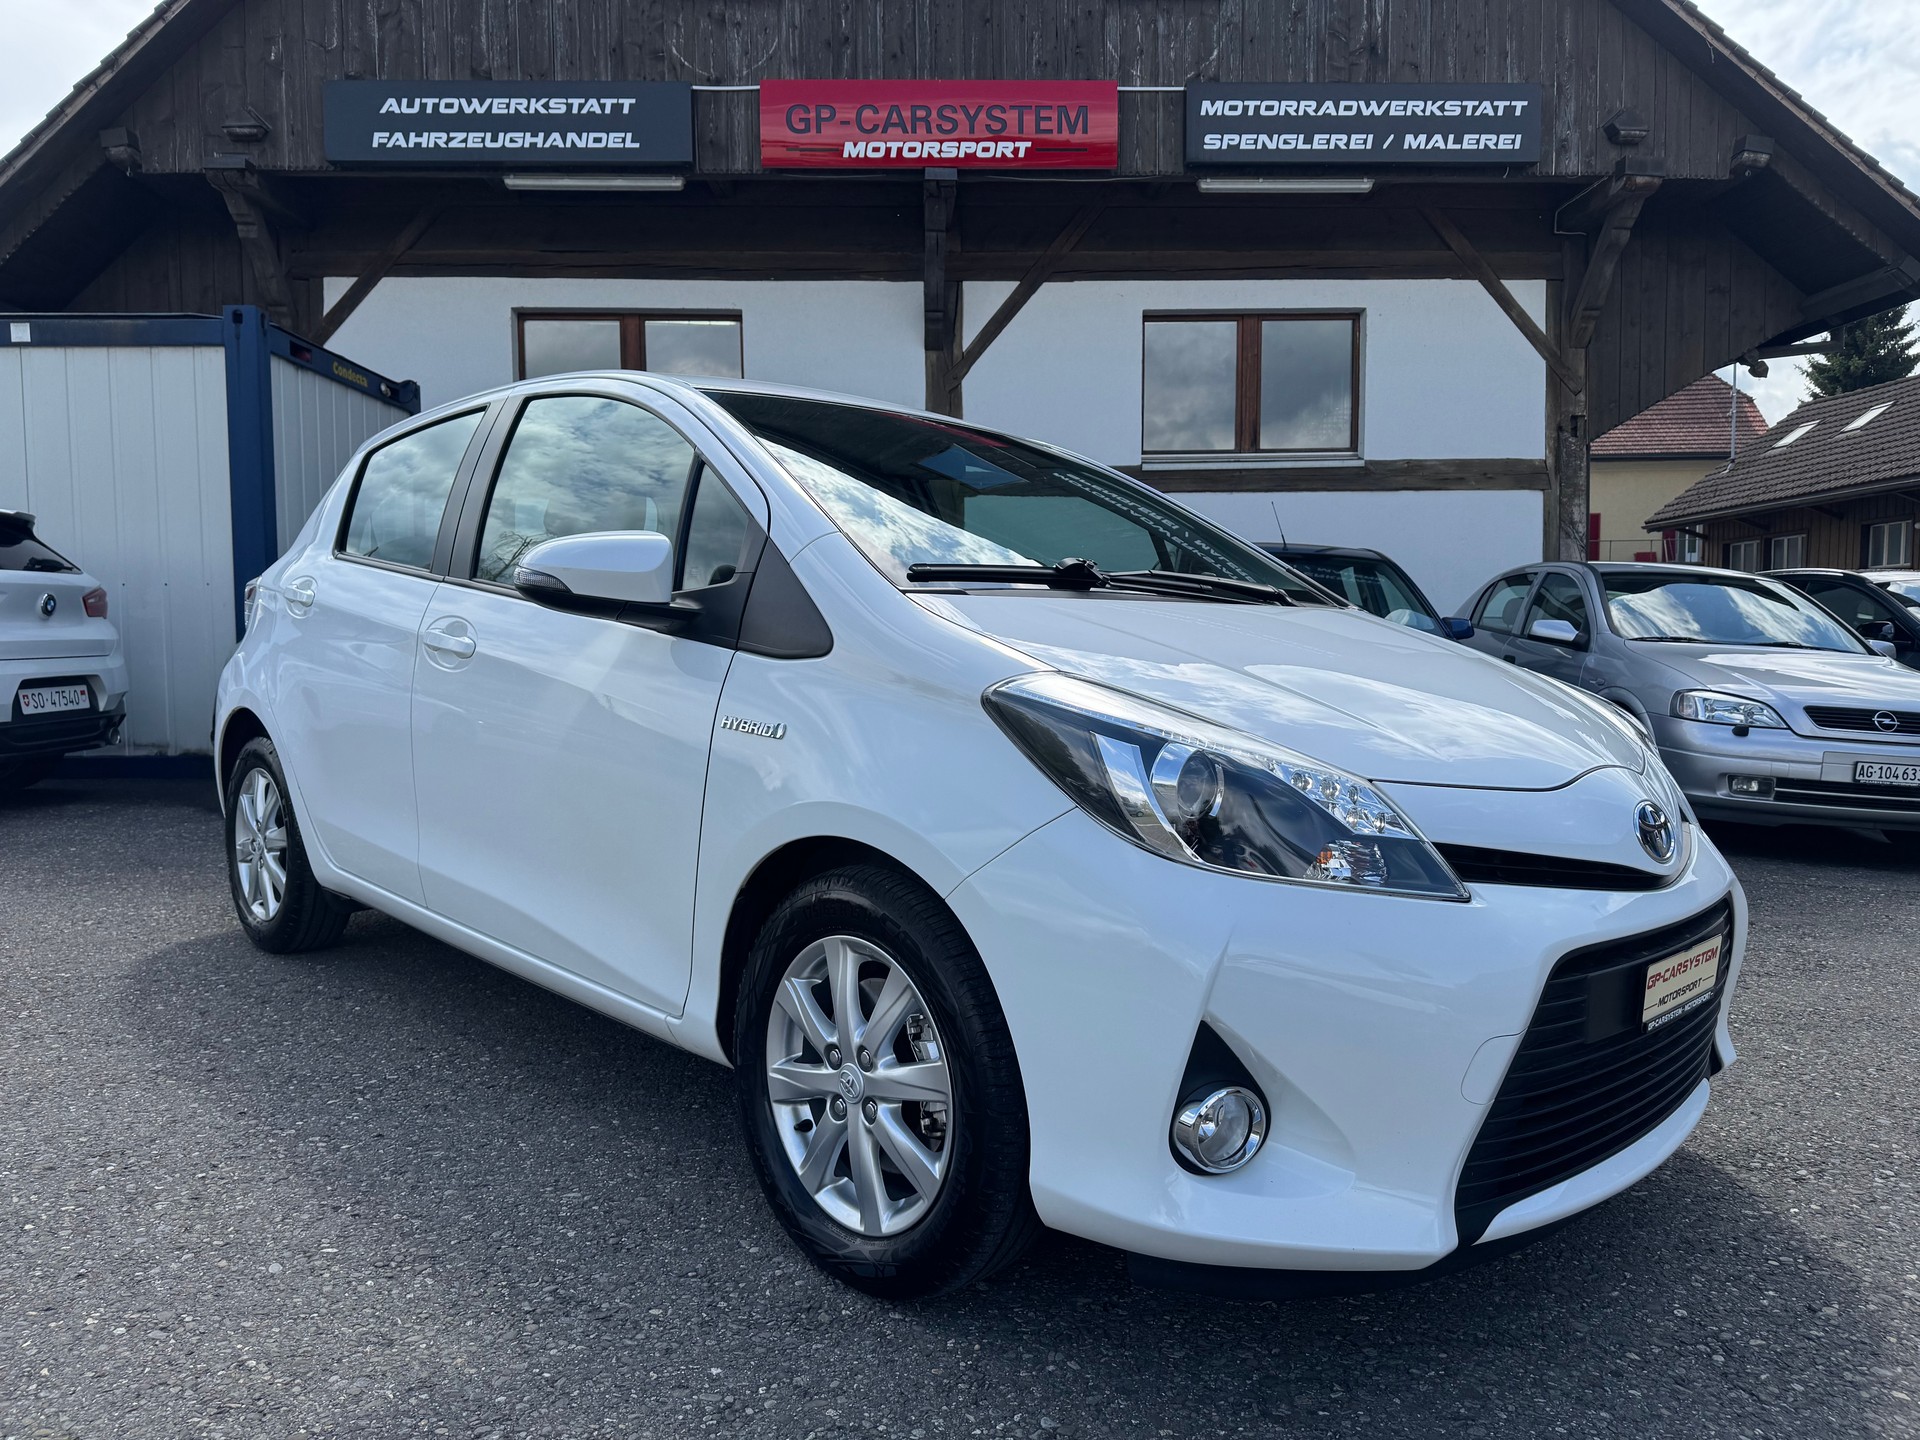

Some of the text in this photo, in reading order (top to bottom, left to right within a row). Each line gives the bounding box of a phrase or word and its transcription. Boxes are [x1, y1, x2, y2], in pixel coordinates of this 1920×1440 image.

[379, 97, 636, 114] AUTOWERKSTATT
[1200, 100, 1528, 116] MOTORRADWERKSTATT
[785, 104, 1089, 135] GP-CARSYSTEM
[372, 132, 640, 148] FAHRZEUGHANDEL
[1203, 134, 1374, 150] SPENGLEREI
[1403, 134, 1522, 150] MALEREI
[842, 141, 1032, 158] MOTORSPORT
[720, 715, 774, 737] HYBRID
[1902, 767, 1920, 781] 63
[1657, 977, 1703, 1007] MOTORSPORT
